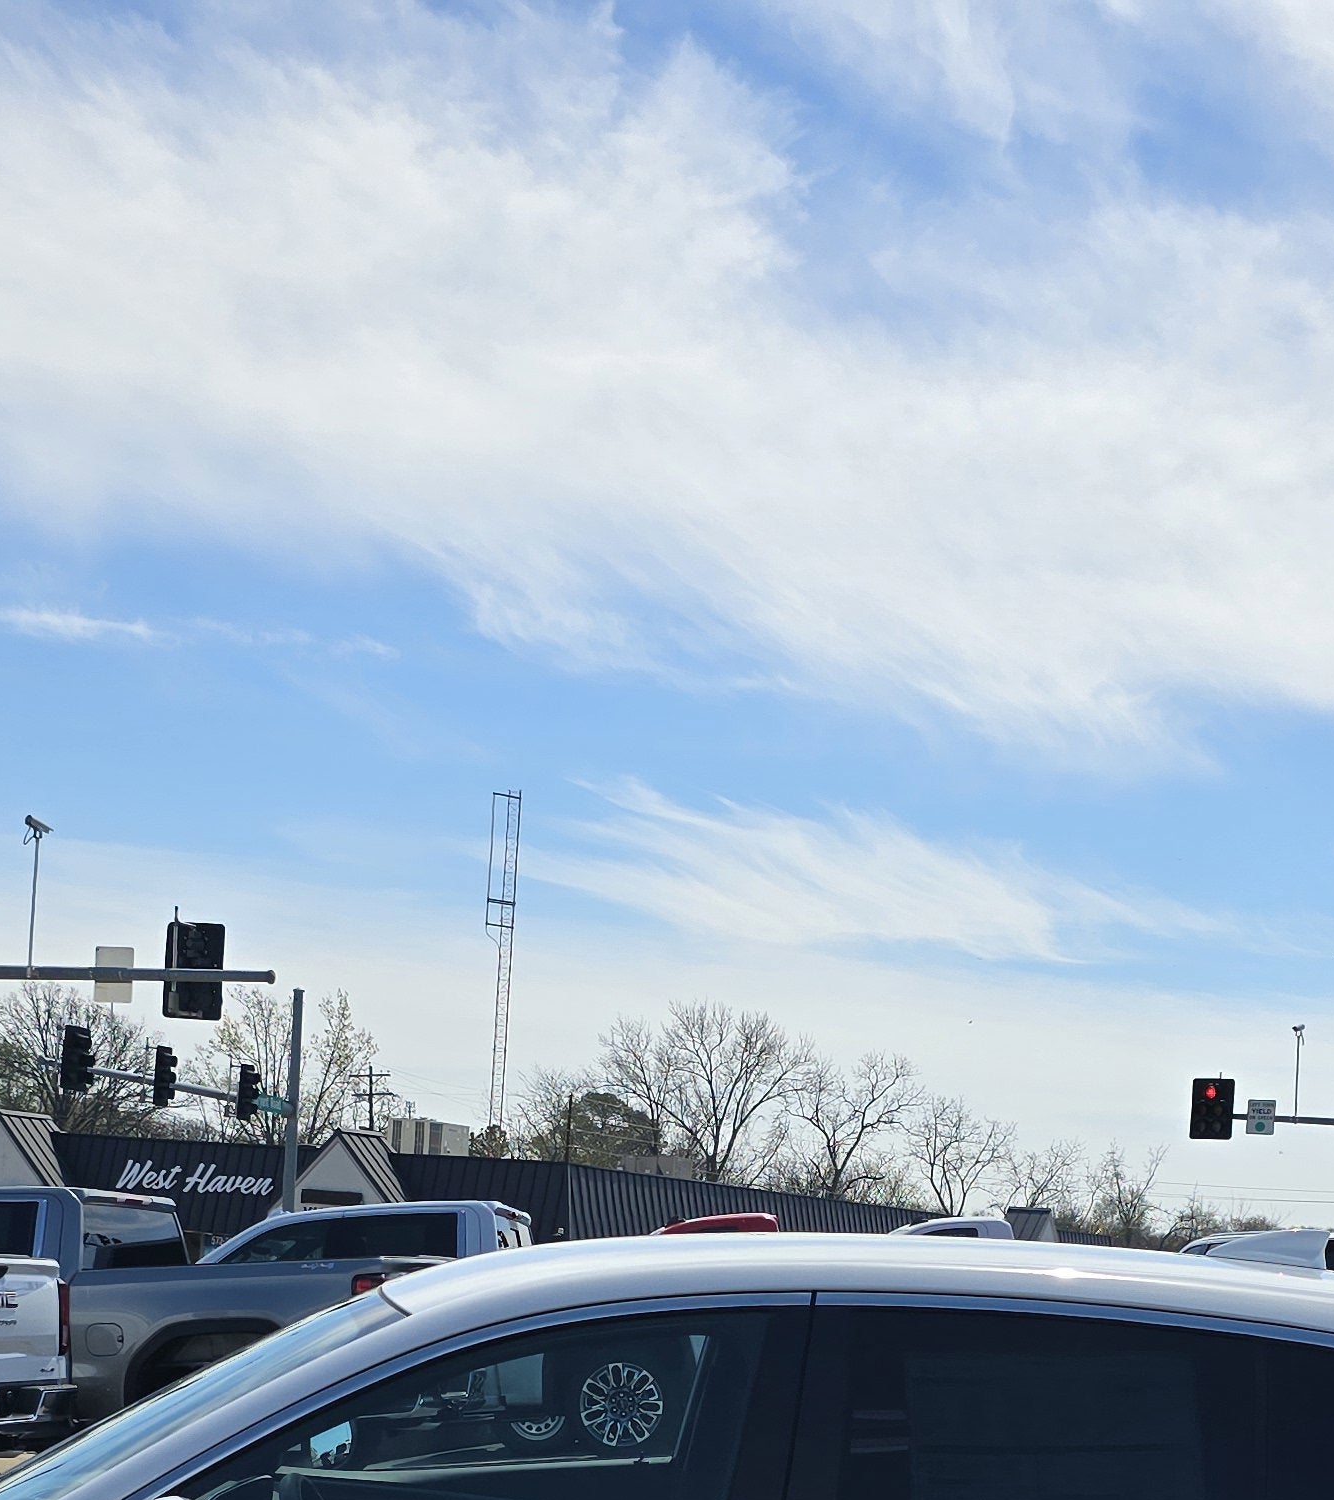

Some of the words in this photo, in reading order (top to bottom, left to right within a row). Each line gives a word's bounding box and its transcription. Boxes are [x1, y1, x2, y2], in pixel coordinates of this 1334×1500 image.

[1251, 1107, 1272, 1115] YIELD
[116, 1159, 182, 1190] West
[182, 1162, 274, 1196] Haven
